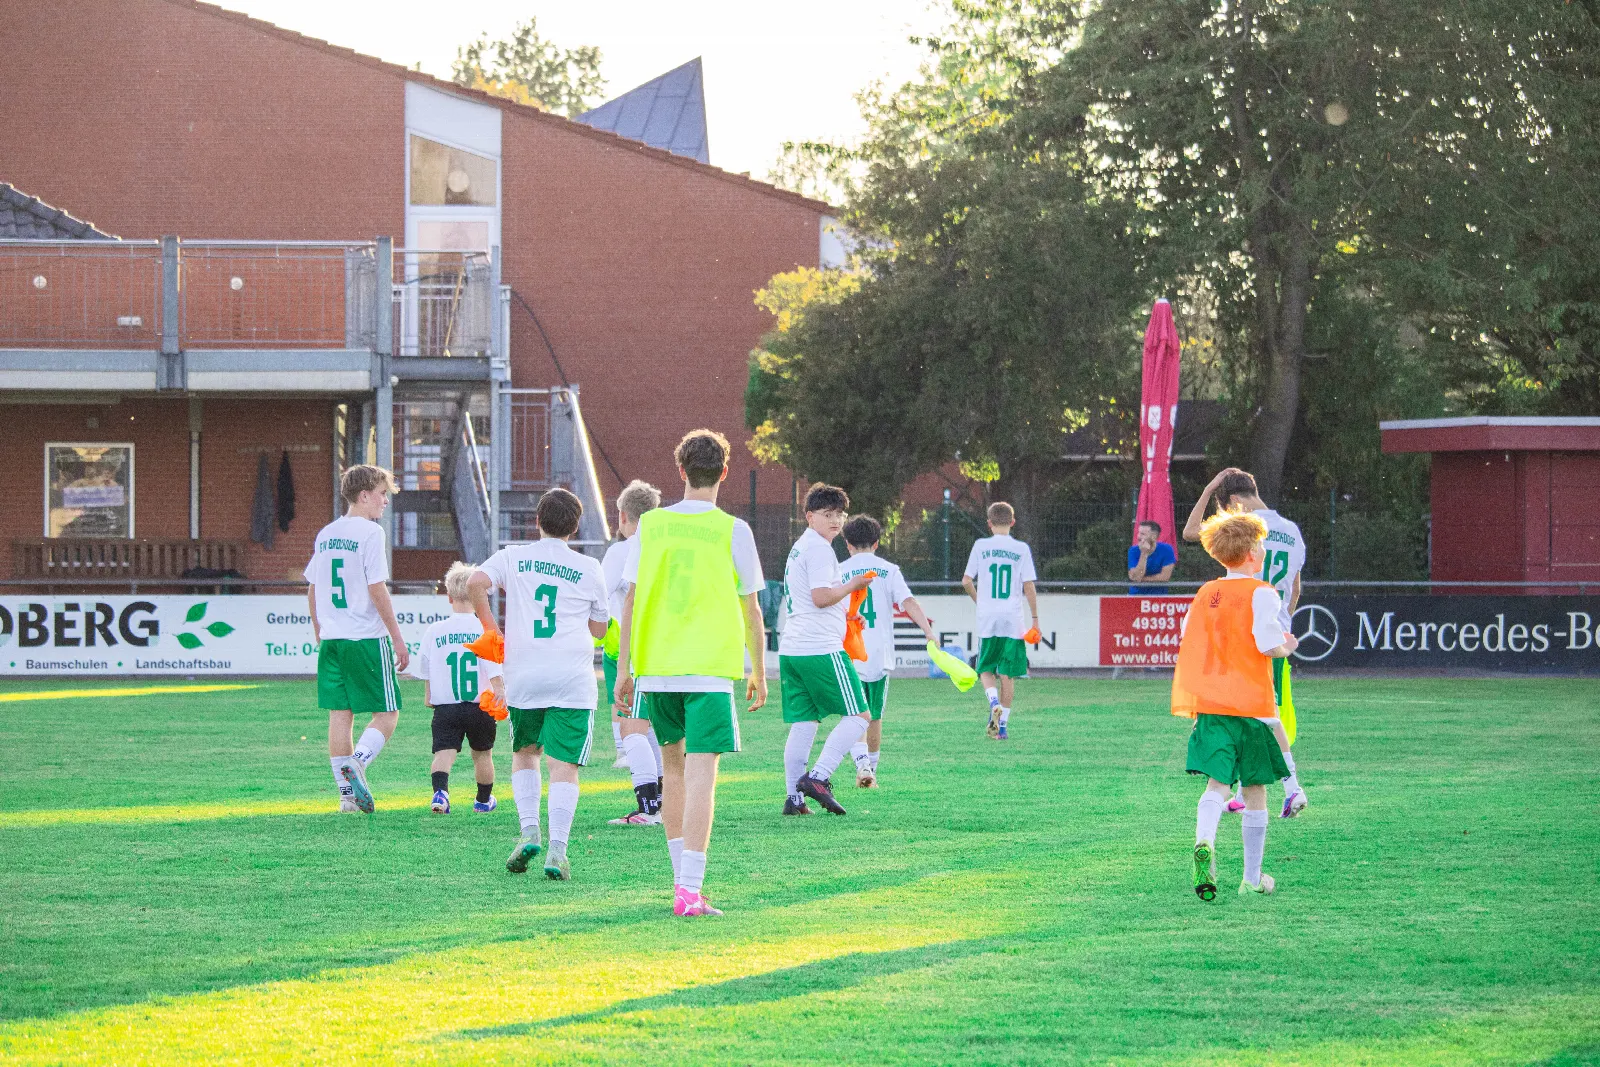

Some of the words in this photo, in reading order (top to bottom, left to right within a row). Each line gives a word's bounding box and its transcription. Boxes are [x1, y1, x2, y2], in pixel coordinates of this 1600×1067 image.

[331, 558, 348, 609] 5
[518, 559, 533, 573] GW
[534, 560, 583, 585] BROCKDORF
[989, 563, 1012, 600] 10
[1263, 549, 1289, 600] 12
[533, 583, 559, 639] 3
[859, 585, 877, 629] 4
[1132, 616, 1176, 630] 49393
[435, 635, 447, 648] GW
[1112, 633, 1140, 648] Tel:
[26, 659, 109, 670] Baumschulen
[135, 659, 232, 670] Landschaftsbau
[445, 651, 479, 702] 16
